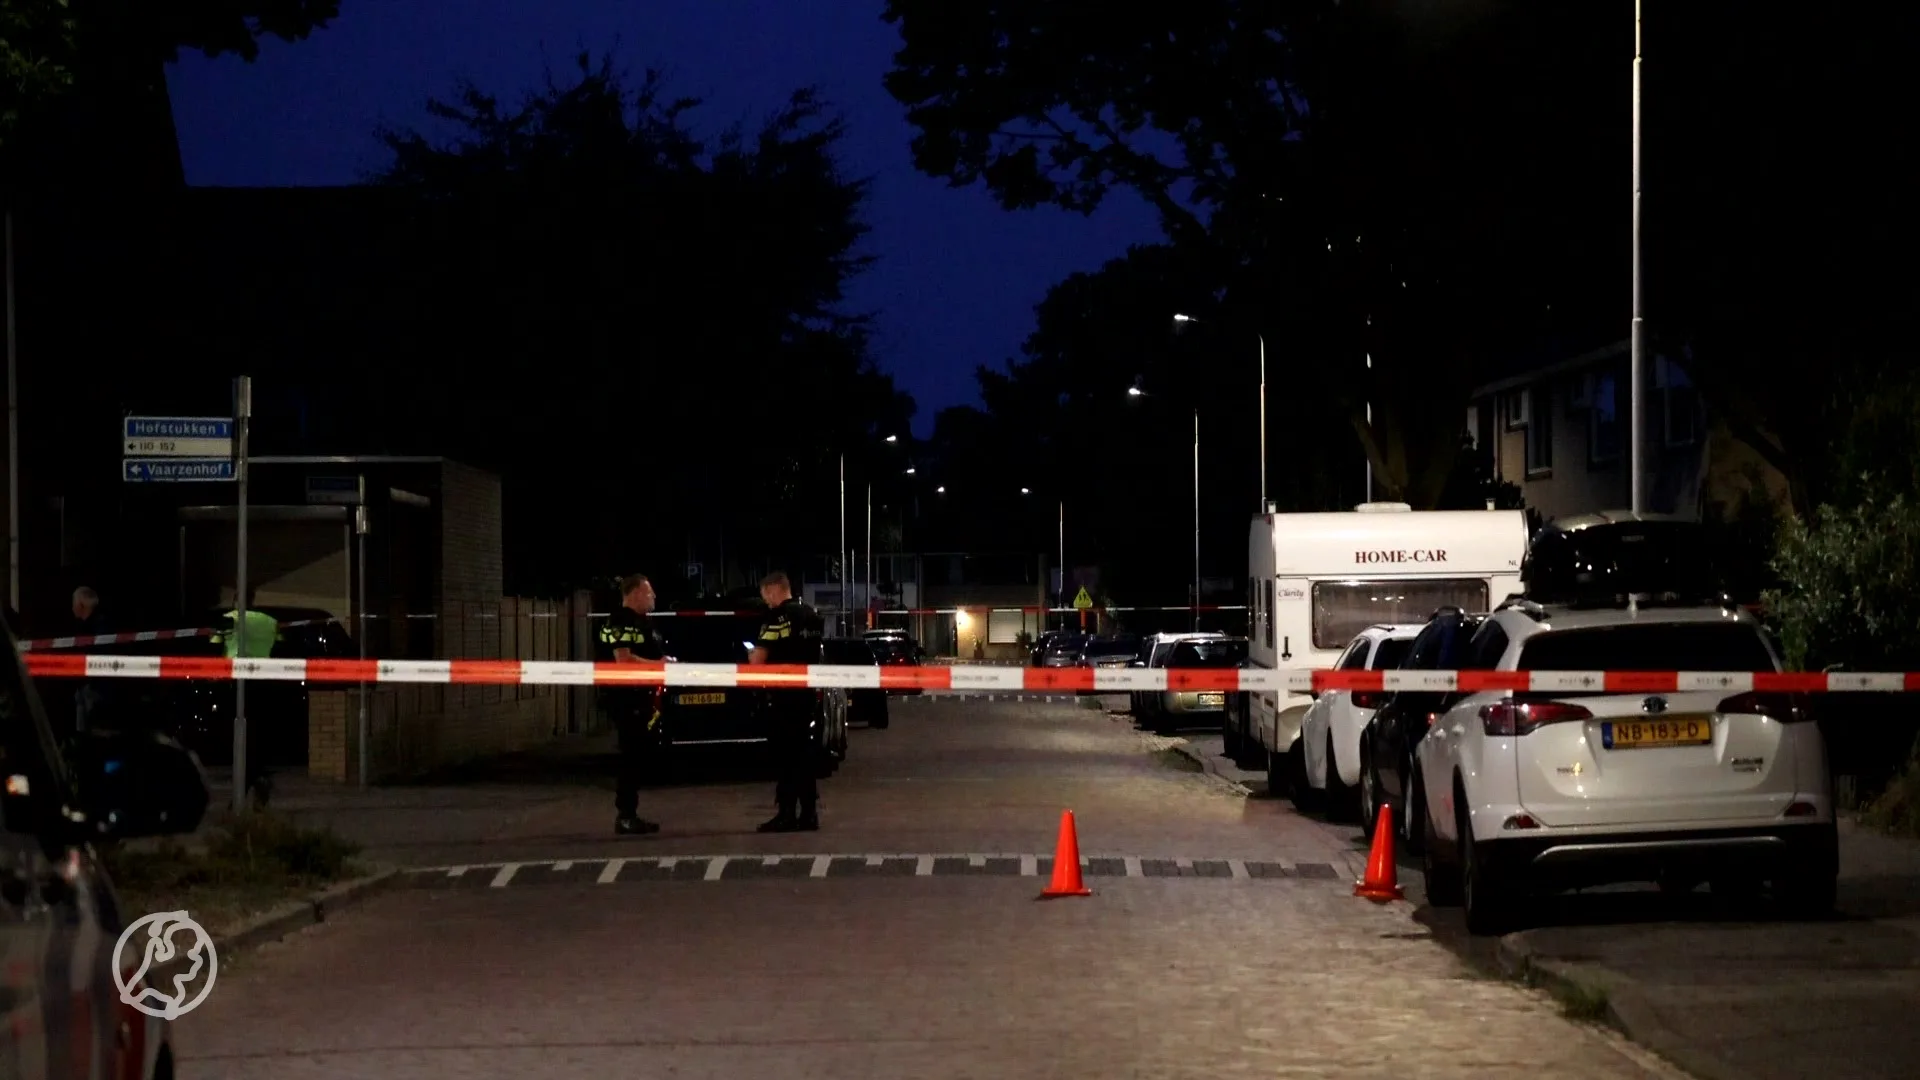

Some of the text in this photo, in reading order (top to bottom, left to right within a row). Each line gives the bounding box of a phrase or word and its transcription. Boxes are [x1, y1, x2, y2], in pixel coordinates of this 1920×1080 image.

[135, 421, 216, 434] Hofstukken
[147, 463, 222, 475] Vaarzenhof
[1355, 549, 1447, 564] HOME-CAR
[1617, 722, 1699, 741] NB-183-D
